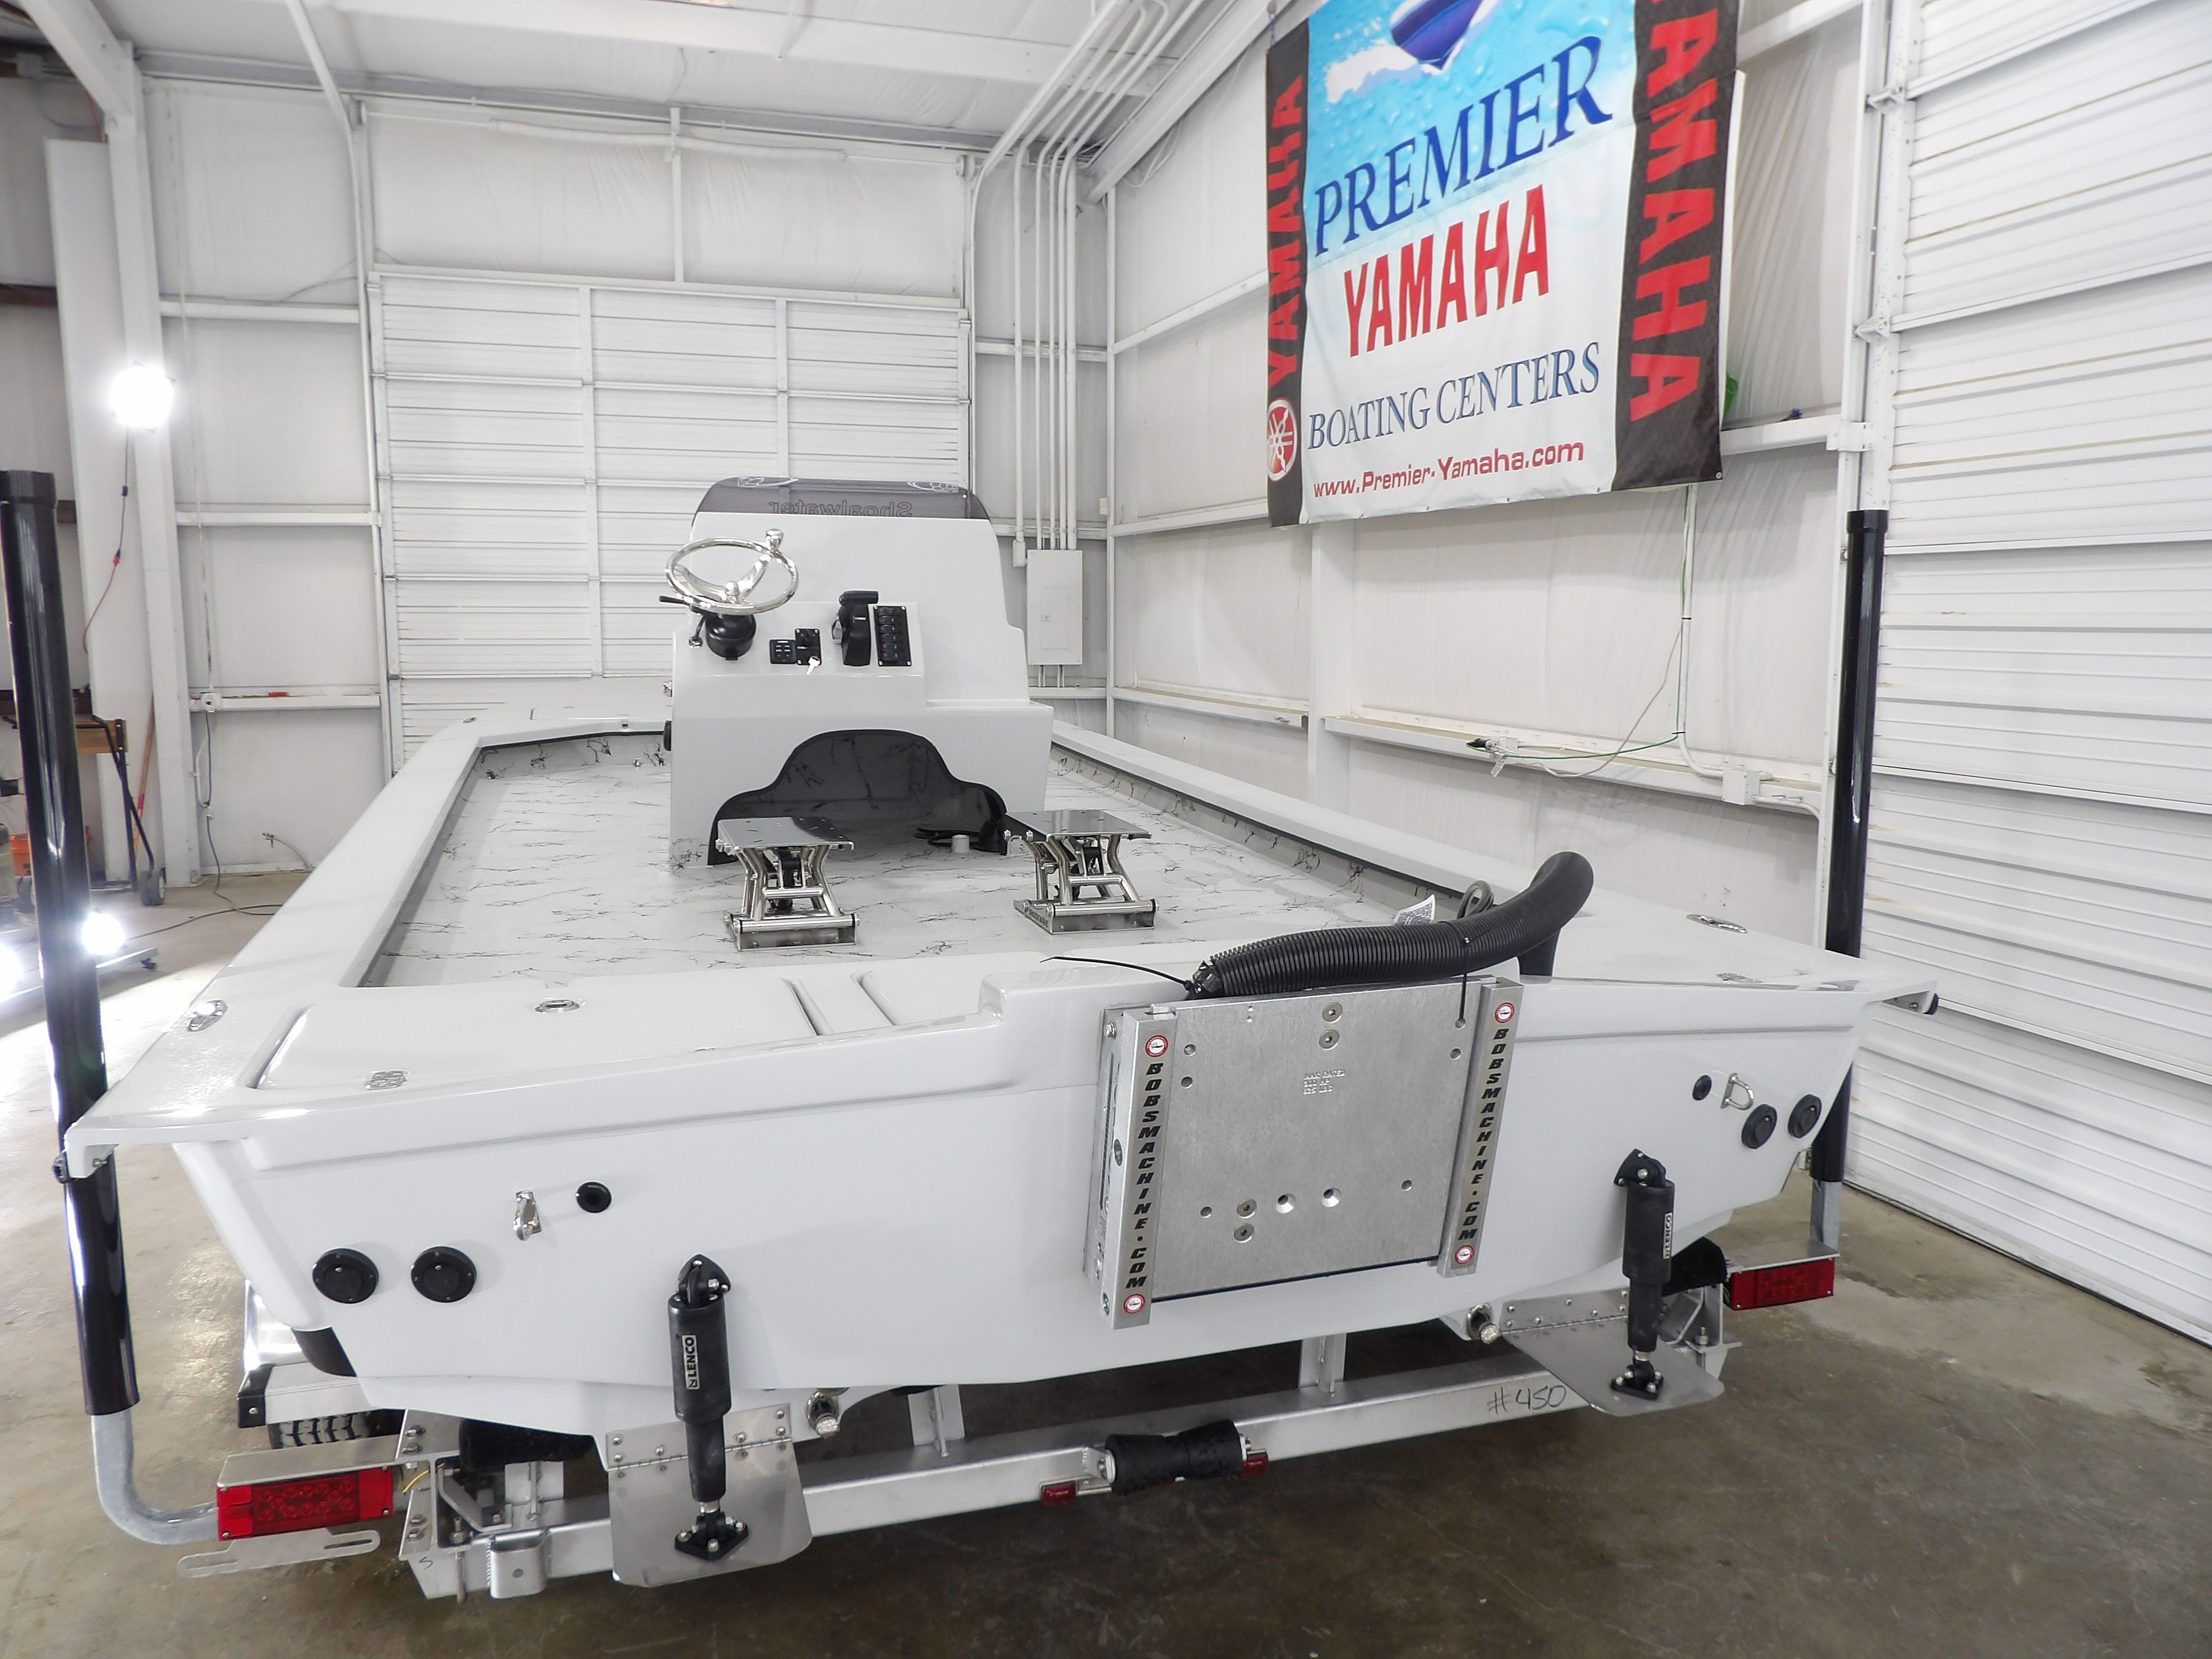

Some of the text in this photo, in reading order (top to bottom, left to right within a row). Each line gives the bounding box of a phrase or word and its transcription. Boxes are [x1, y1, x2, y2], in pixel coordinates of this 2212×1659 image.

[1314, 36, 1612, 257] PREMIER
[1629, 0, 1719, 421] AMAHA
[1344, 184, 1550, 358] YAMAHA
[1308, 341, 1599, 450] BOATING CENTERS
[1313, 441, 1584, 498] www.Premier-Yamaha.com
[1125, 1063, 1164, 1289] BOBSMACHINE.COM
[1458, 1028, 1509, 1241] BOBSMACHINE.COM
[684, 1336, 697, 1377] LENCO
[1487, 1385, 1566, 1414] #450
